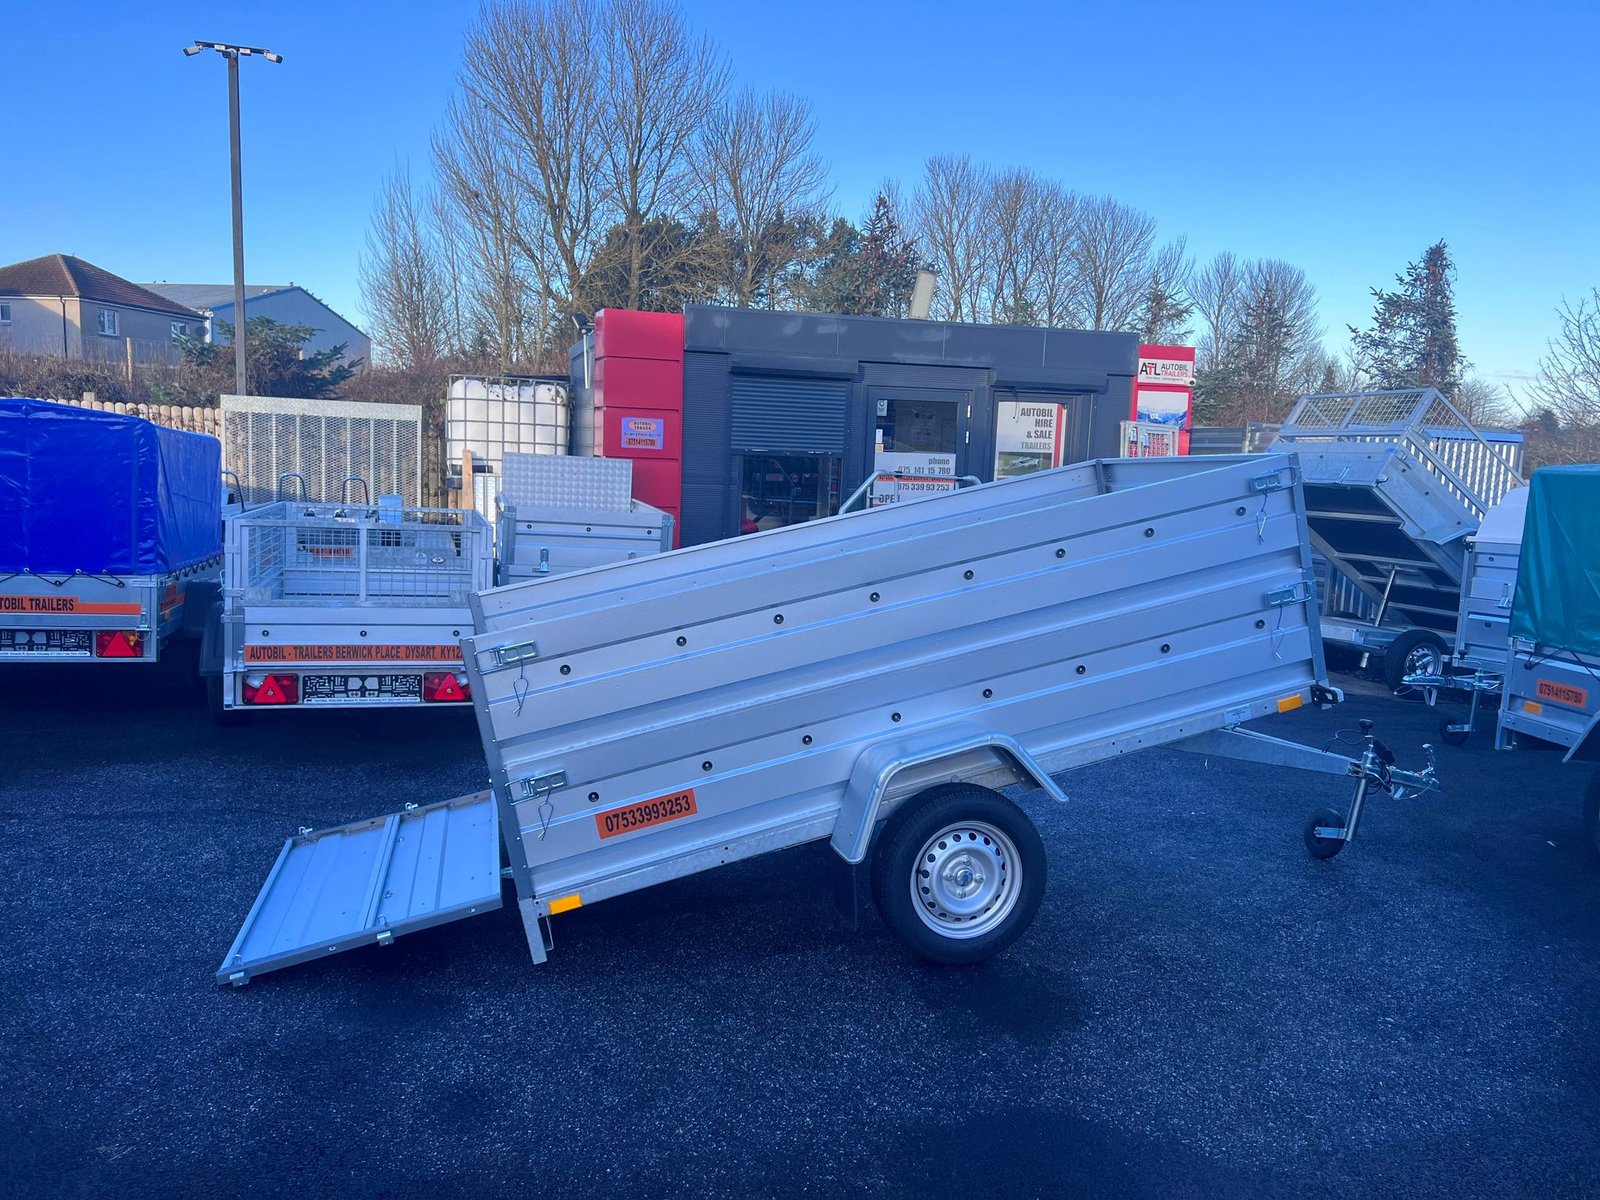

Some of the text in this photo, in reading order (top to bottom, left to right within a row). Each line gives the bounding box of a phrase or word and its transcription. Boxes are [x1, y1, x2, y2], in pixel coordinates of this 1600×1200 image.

[1139, 362, 1161, 376] ATL
[1161, 363, 1189, 371] AUTOBIL
[1161, 370, 1189, 378] TRAILERS
[1020, 407, 1054, 418] AUTOBIL
[1034, 418, 1053, 428] HIRE
[1026, 429, 1053, 439] & SALE
[1021, 441, 1052, 450] TRAILERS
[928, 457, 950, 465] phone
[897, 466, 951, 475] 075 141 15 780
[897, 482, 950, 492] 075 339 93 253
[878, 494, 900, 504] OPE
[29, 598, 74, 611] TRAILERS
[250, 646, 286, 659] AUTOBIL
[293, 646, 334, 659] TRAILERS
[336, 646, 373, 659] BERWICK
[440, 645, 463, 659] KY12
[1539, 682, 1583, 705] 07514115780
[605, 795, 691, 832] 07533993253
